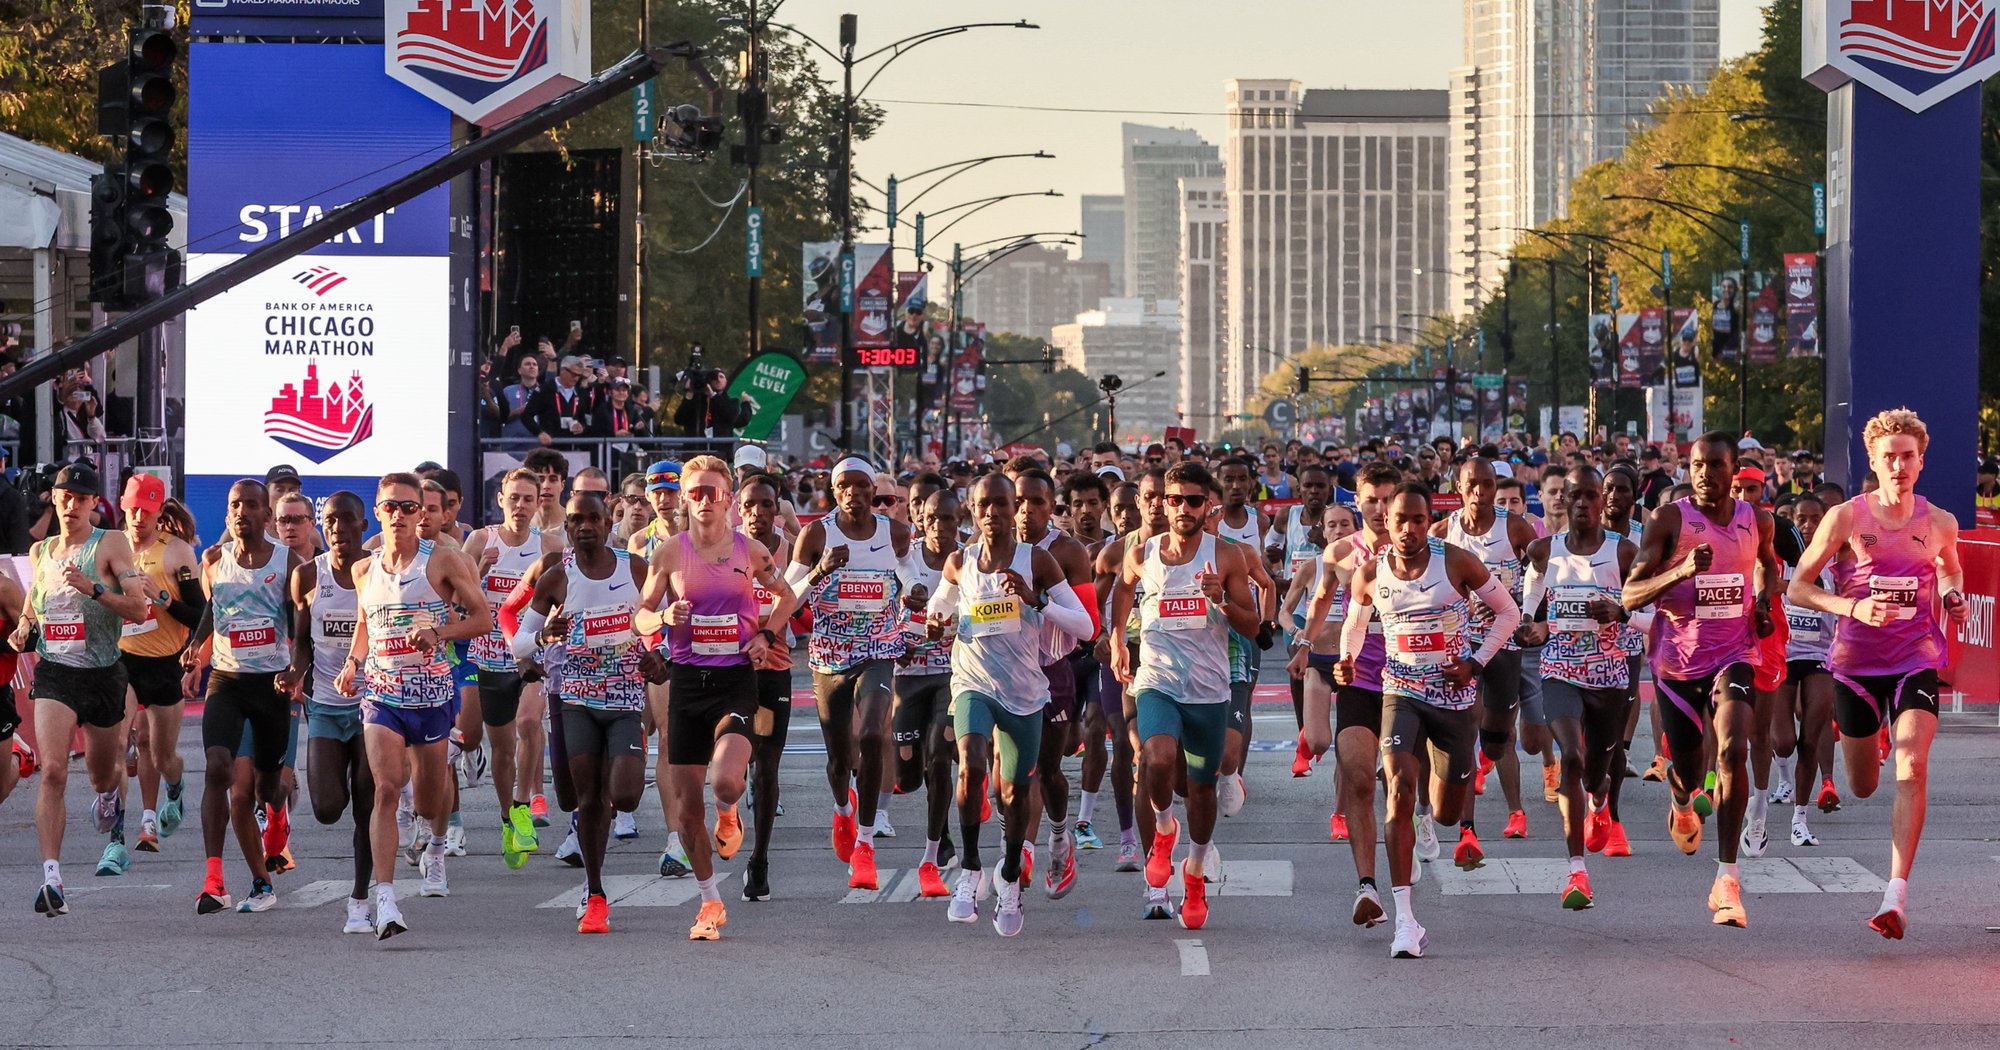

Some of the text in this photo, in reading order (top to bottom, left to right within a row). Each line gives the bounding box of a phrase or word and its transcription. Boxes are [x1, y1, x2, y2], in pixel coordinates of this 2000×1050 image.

[637, 82, 649, 132] 121
[747, 213, 761, 270] C131
[842, 258, 854, 307] C141
[265, 302, 374, 312] BANK OF AMERICA
[264, 315, 374, 337] CHICAGO
[264, 339, 374, 356] MARATHON
[755, 362, 792, 381] ALERT
[752, 375, 787, 394] LEVEL
[494, 578, 521, 589] RUP
[840, 583, 882, 594] EBENYO
[1698, 587, 1742, 601] PACE 2
[1870, 589, 1916, 602] PE 17
[975, 601, 1014, 616] KORIR
[1163, 600, 1200, 611] TALBI
[1556, 602, 1586, 614] PACE
[325, 621, 356, 633] PACE
[586, 620, 591, 631] J
[592, 615, 629, 629] KIPLIMO
[1787, 615, 1819, 628] FEYSA
[1966, 592, 1996, 649] ABBOTT
[50, 625, 78, 636] FORD
[238, 629, 267, 643] ABDI
[693, 628, 737, 636] LINKLETTER
[378, 638, 408, 651] MANT
[1407, 635, 1433, 647] ESA
